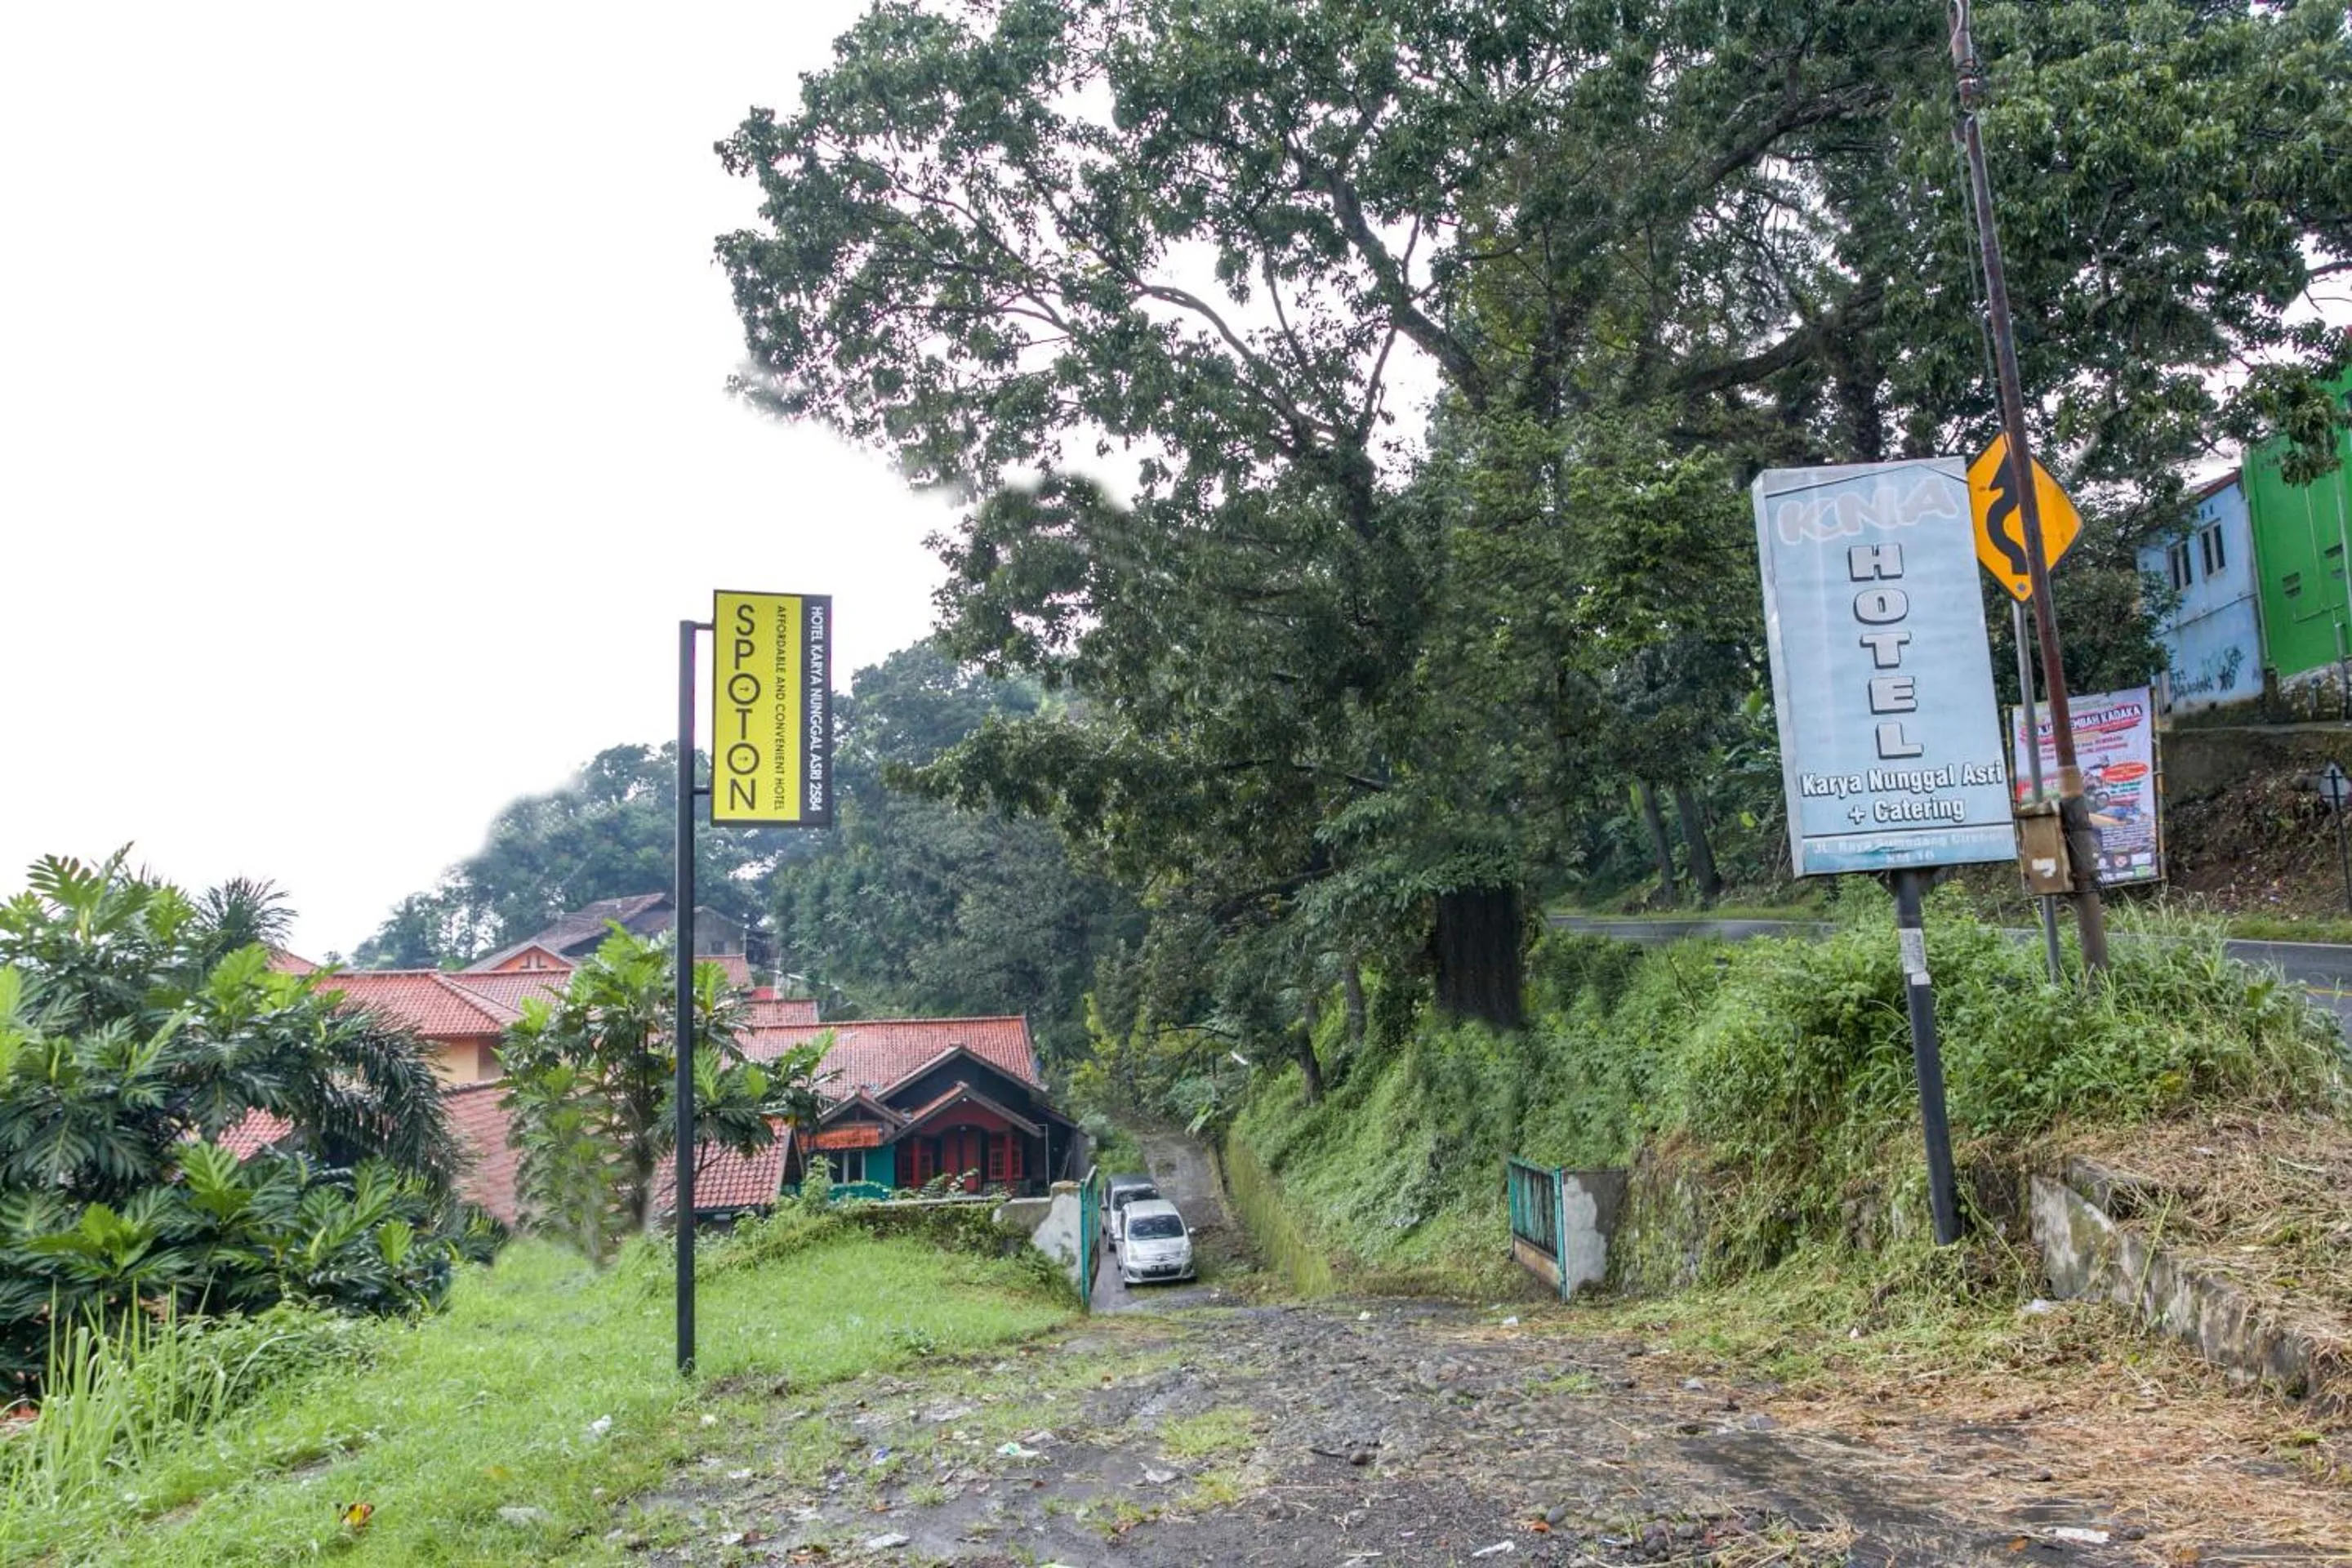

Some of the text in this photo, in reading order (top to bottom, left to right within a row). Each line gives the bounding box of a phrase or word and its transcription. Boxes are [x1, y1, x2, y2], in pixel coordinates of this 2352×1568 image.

[1778, 476, 1960, 545] KNA
[810, 606, 824, 642] HOTEL
[809, 644, 823, 685] KARYA
[1848, 542, 1924, 759] HOTEL
[774, 605, 786, 811] AFFORDABLE AND CONVENIENT HOTEL
[809, 688, 823, 751] NUNGGAL
[809, 752, 823, 780] ASRI
[1801, 761, 2004, 800] Karya Nunggal Asri
[1874, 797, 1965, 822] Catering
